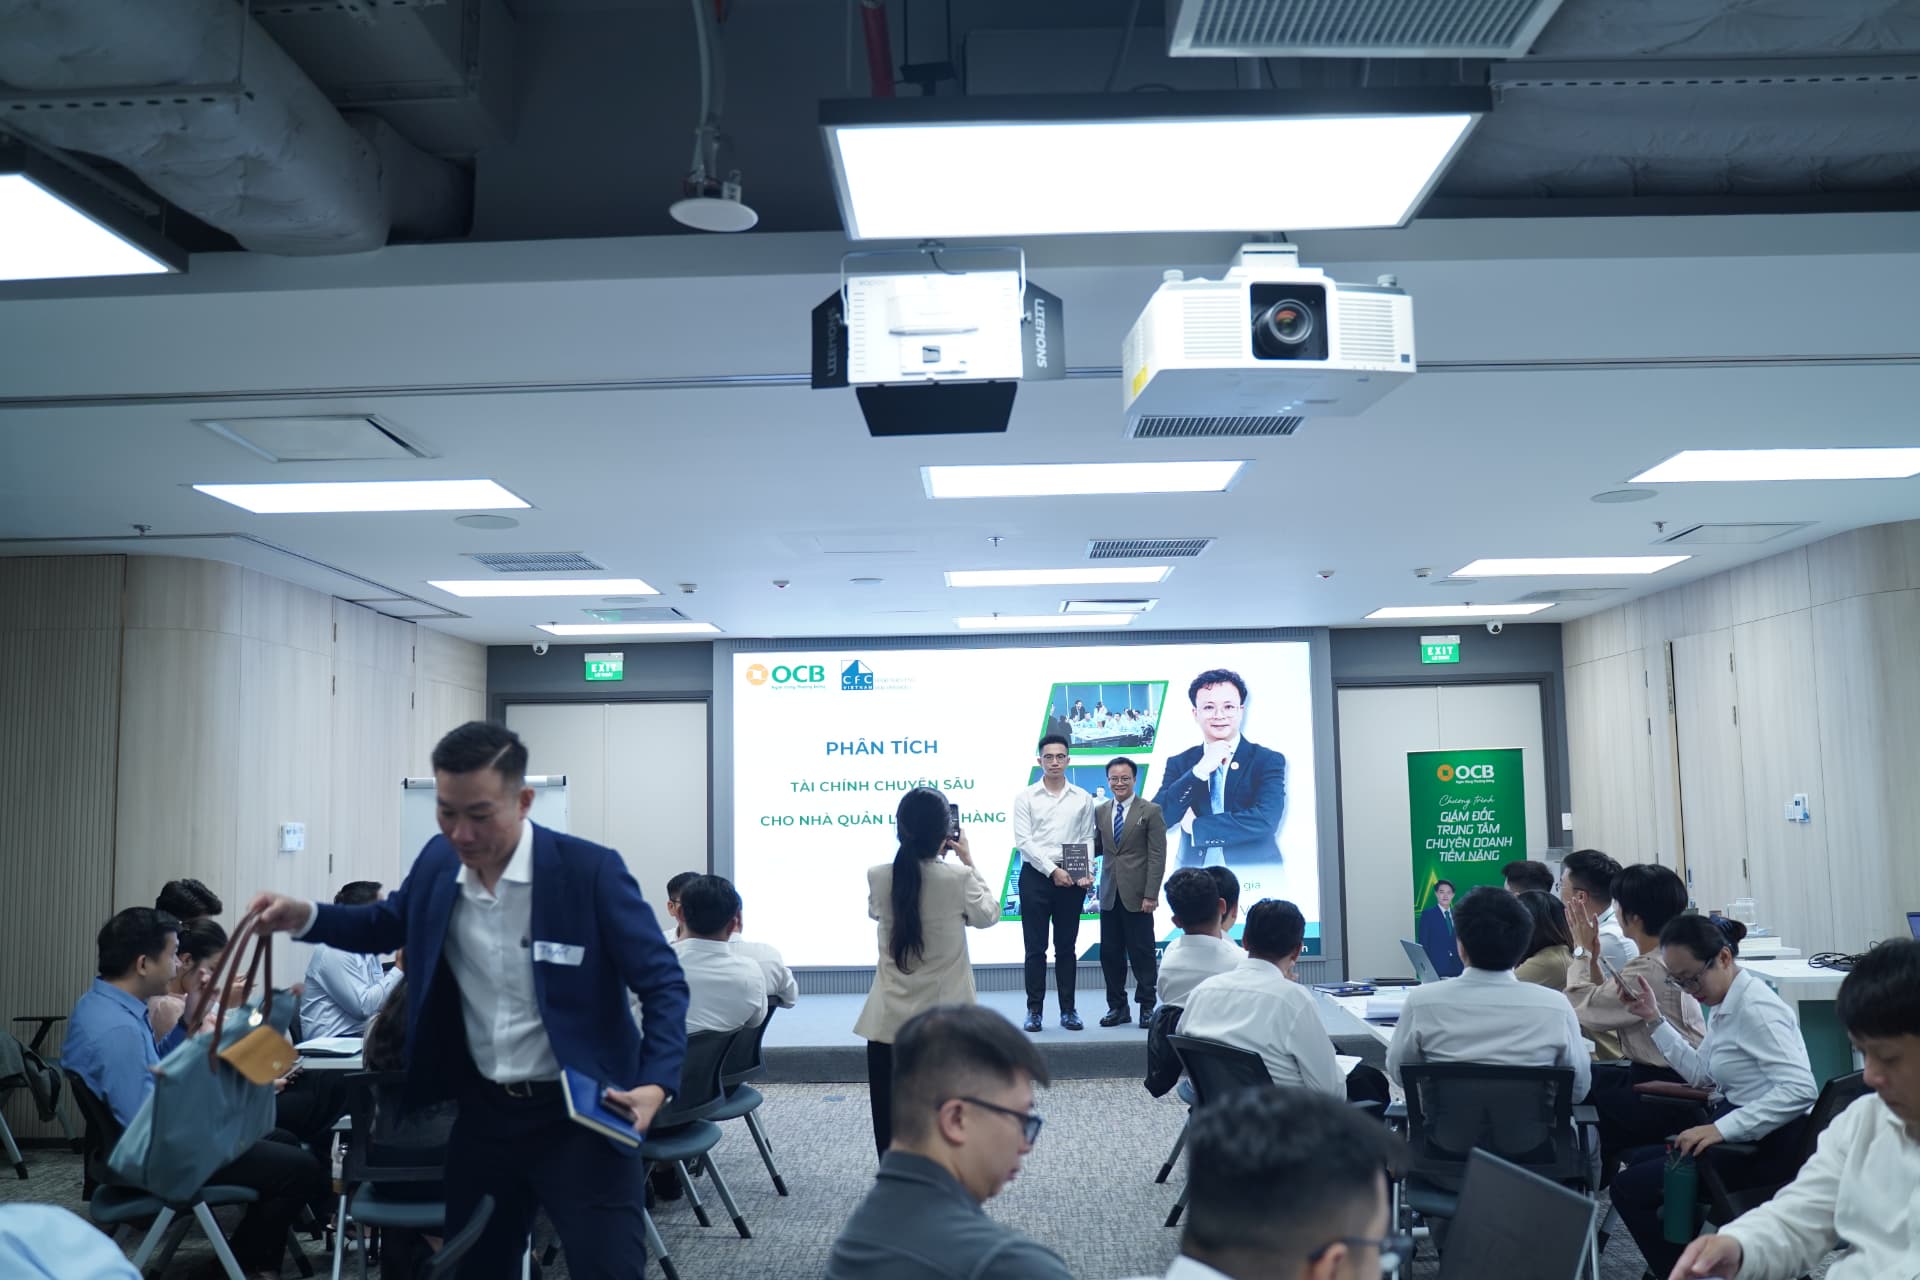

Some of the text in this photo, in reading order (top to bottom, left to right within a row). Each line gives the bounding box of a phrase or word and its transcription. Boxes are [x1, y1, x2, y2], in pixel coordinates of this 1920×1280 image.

[1034, 298, 1048, 369] LITEMONS
[1427, 646, 1454, 656] EXIT
[591, 663, 617, 672] EXIT
[771, 665, 825, 683] OCB
[826, 736, 938, 756] PHÂN TÍCH
[1455, 765, 1495, 780] OCB
[790, 778, 815, 792] TÀI
[820, 778, 869, 792] CHÍNH
[760, 815, 795, 826] CHO
[799, 811, 833, 826] NHÀ
[961, 809, 1006, 824] HÀNG
[1440, 806, 1496, 822] GIÁM ĐỐC
[1437, 824, 1474, 836] TRUNG
[1425, 836, 1513, 849] CHUYÊN DOANH
[1468, 848, 1500, 861] NĂNG
[1243, 881, 1261, 892] gia
